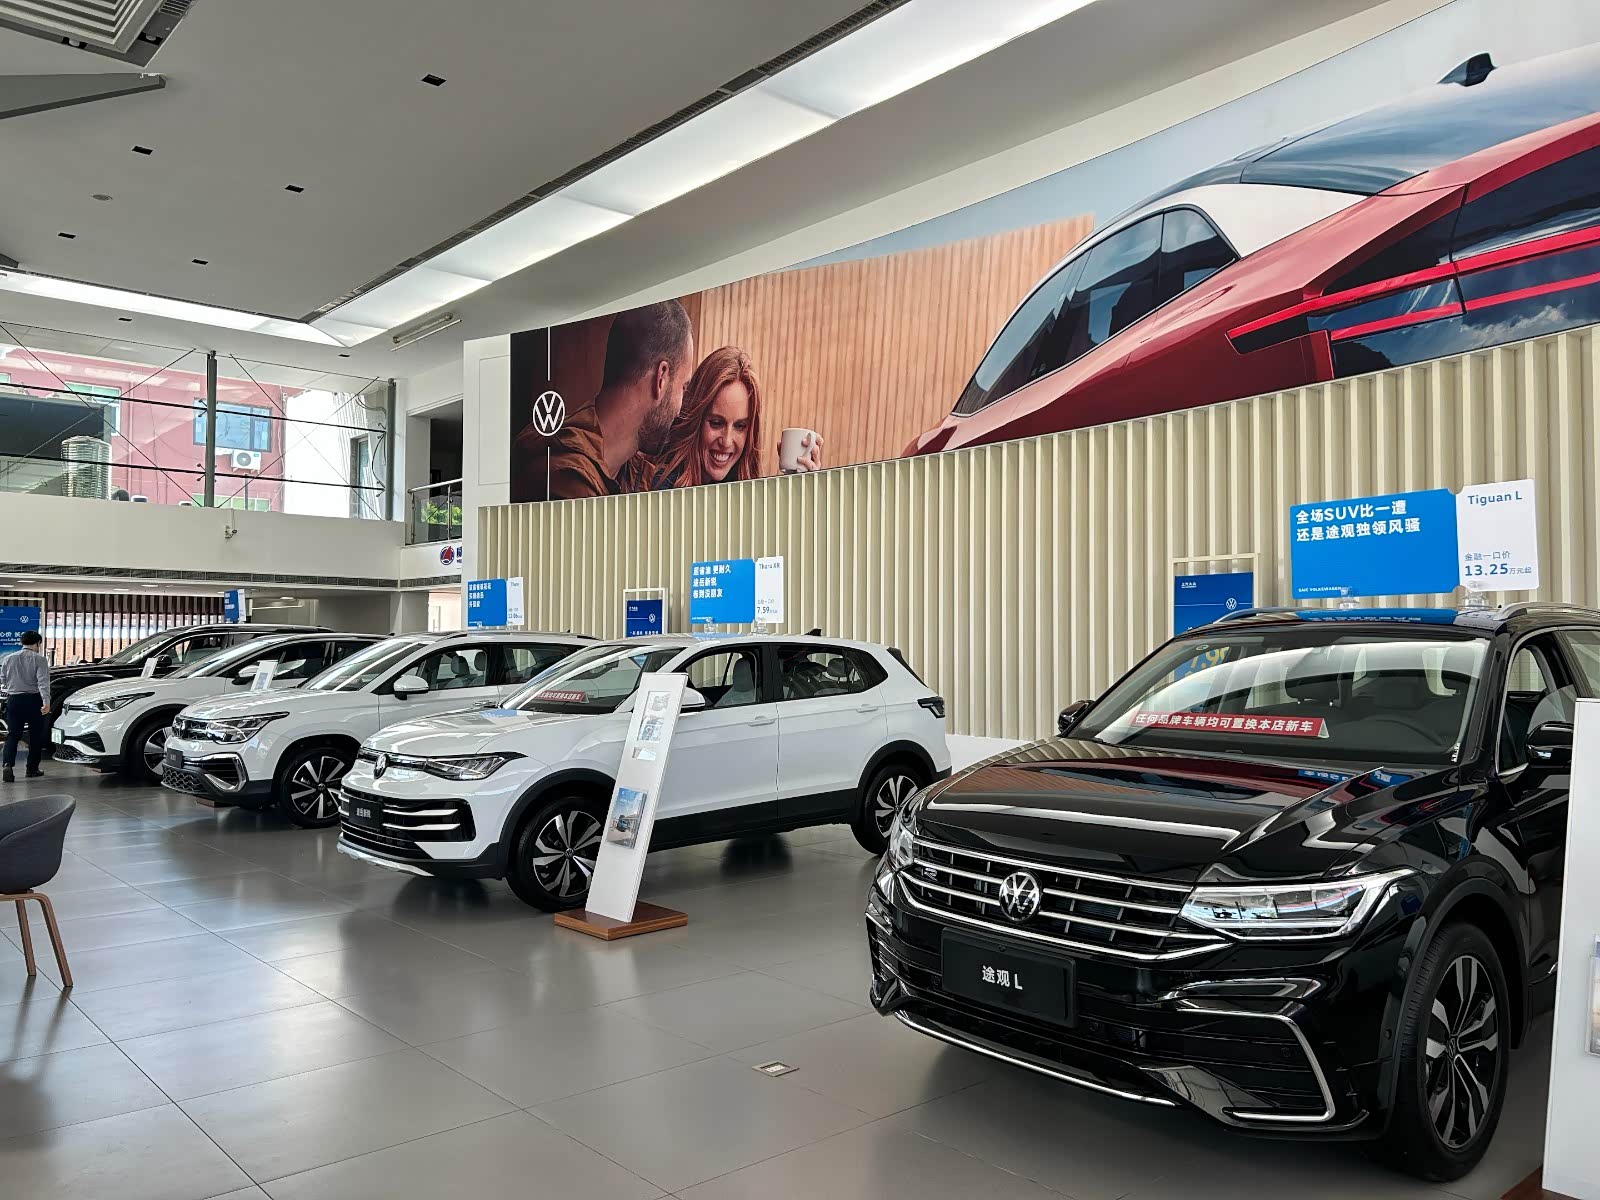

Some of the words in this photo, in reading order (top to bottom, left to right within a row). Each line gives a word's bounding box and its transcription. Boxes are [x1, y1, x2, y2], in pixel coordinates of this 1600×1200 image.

[1467, 493, 1512, 506] Tiguan
[1515, 490, 1523, 500] L
[1296, 500, 1407, 524] 全场SUV比一遭
[1296, 518, 1421, 542] 还是途观独领风骚
[1464, 550, 1511, 562] 金融一口价
[1464, 563, 1532, 577] 13.25万元起
[1135, 713, 1314, 733] 任何品牌车辆均可置换本店新车
[981, 965, 1010, 988] 途观
[1014, 973, 1023, 990] L
